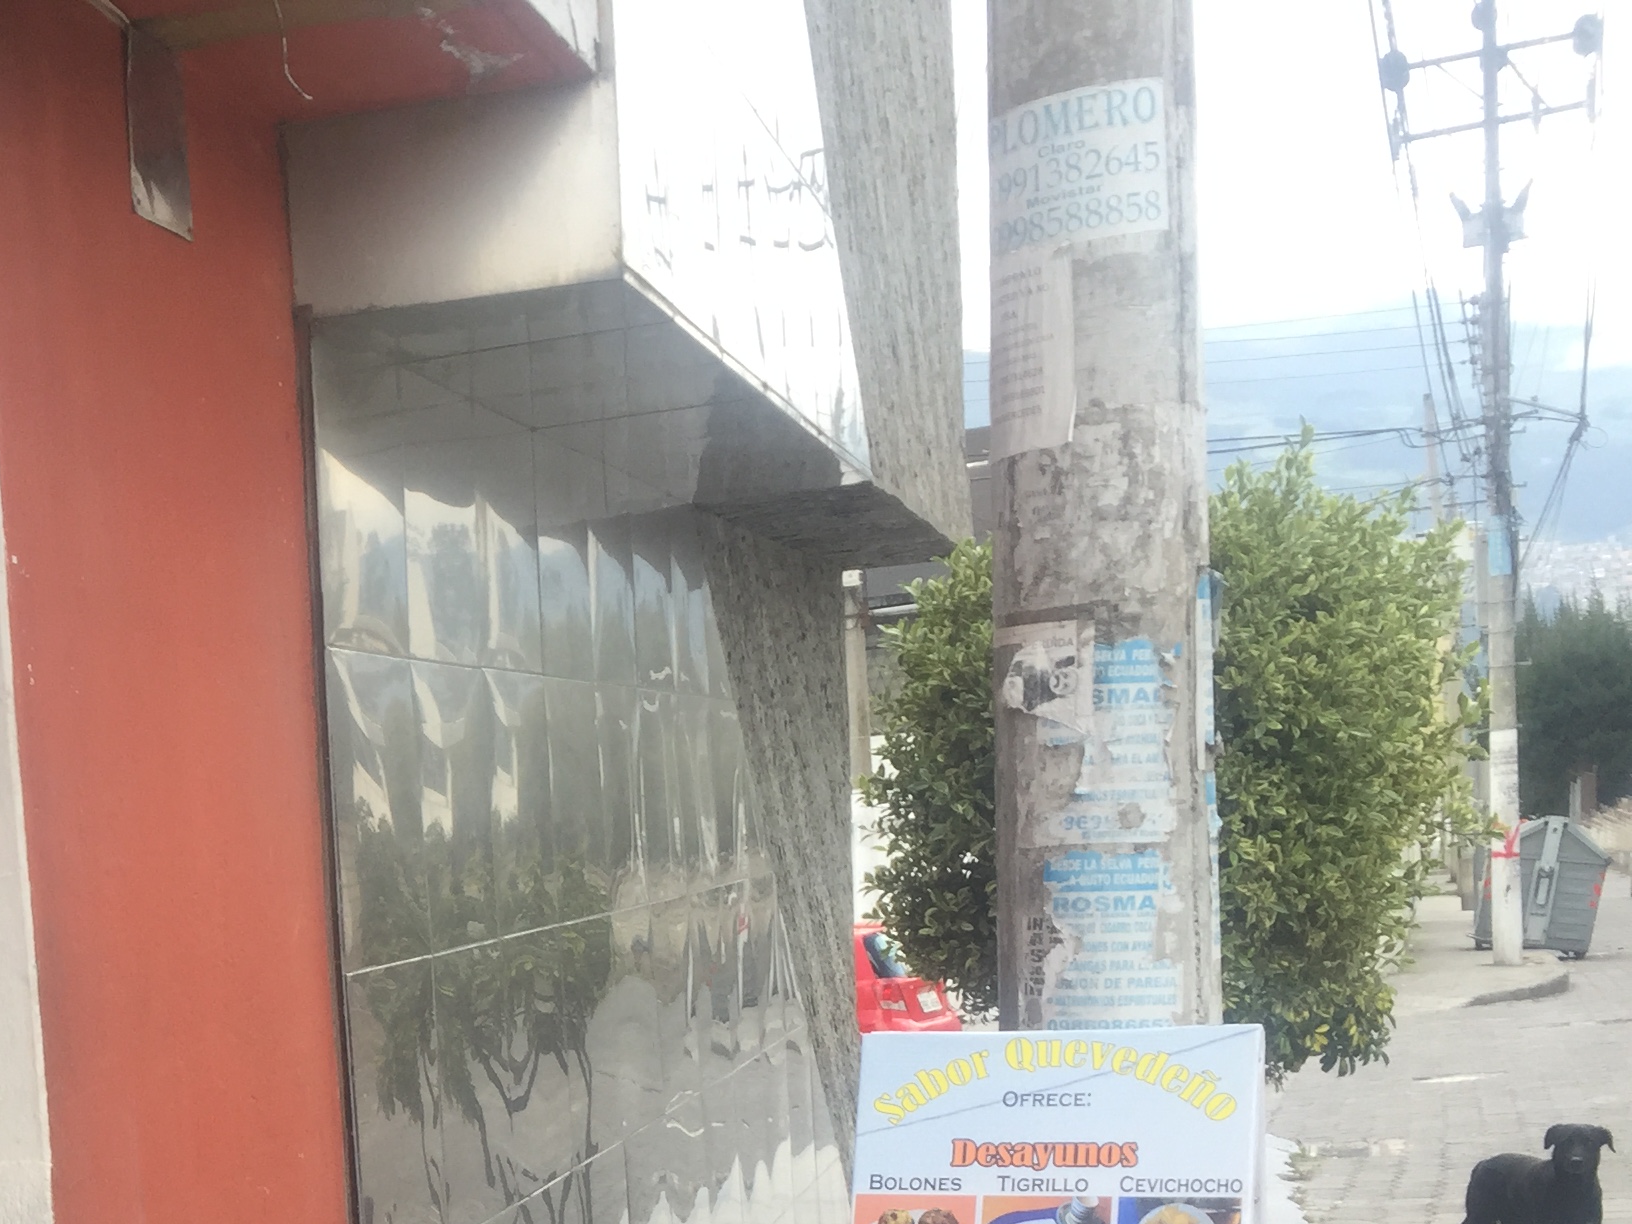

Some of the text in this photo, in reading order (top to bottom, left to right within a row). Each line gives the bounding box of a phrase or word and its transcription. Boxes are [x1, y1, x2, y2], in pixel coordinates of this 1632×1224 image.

[1037, 139, 1087, 159] Claro
[1026, 183, 1103, 209] Movistar
[1084, 859, 1097, 870] LA
[1100, 858, 1133, 870] SELVA
[1103, 977, 1122, 990] DE
[1126, 975, 1178, 990] PAREJA
[873, 1036, 1238, 1127] Sabor Quevedeño
[950, 1138, 1140, 1170] Desayunos
